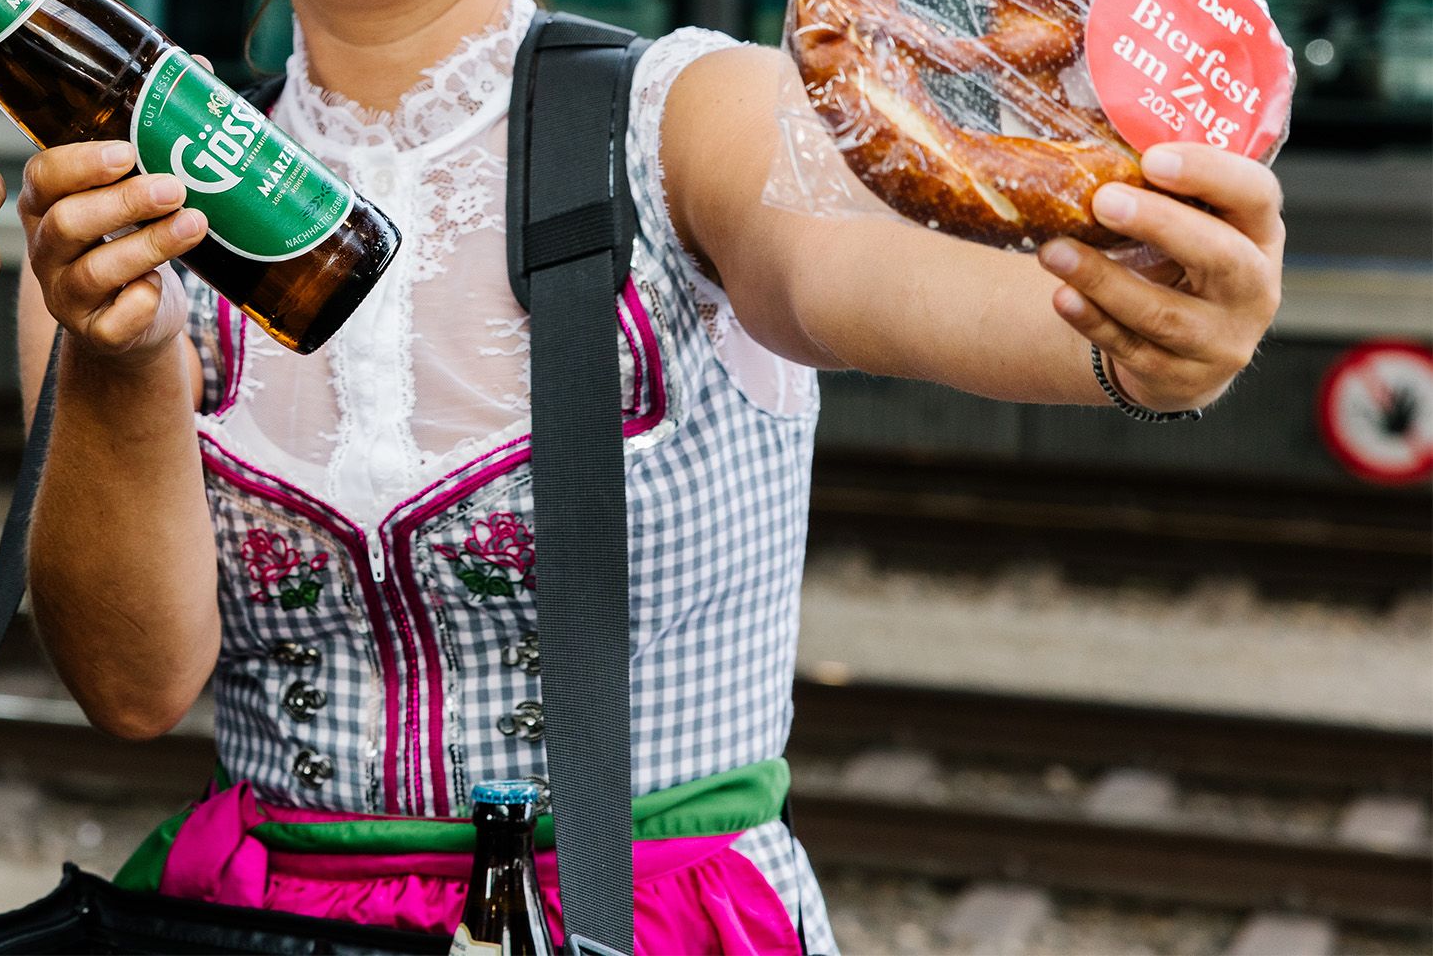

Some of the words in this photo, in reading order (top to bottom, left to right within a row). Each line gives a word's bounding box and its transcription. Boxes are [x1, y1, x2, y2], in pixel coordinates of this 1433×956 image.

[143, 103, 157, 127] GUT
[152, 66, 177, 101] BESSER
[1112, 34, 1168, 85] am
[1170, 72, 1240, 150] Zug
[1138, 88, 1186, 132] 2023
[285, 212, 333, 248] NACHHALTIG
